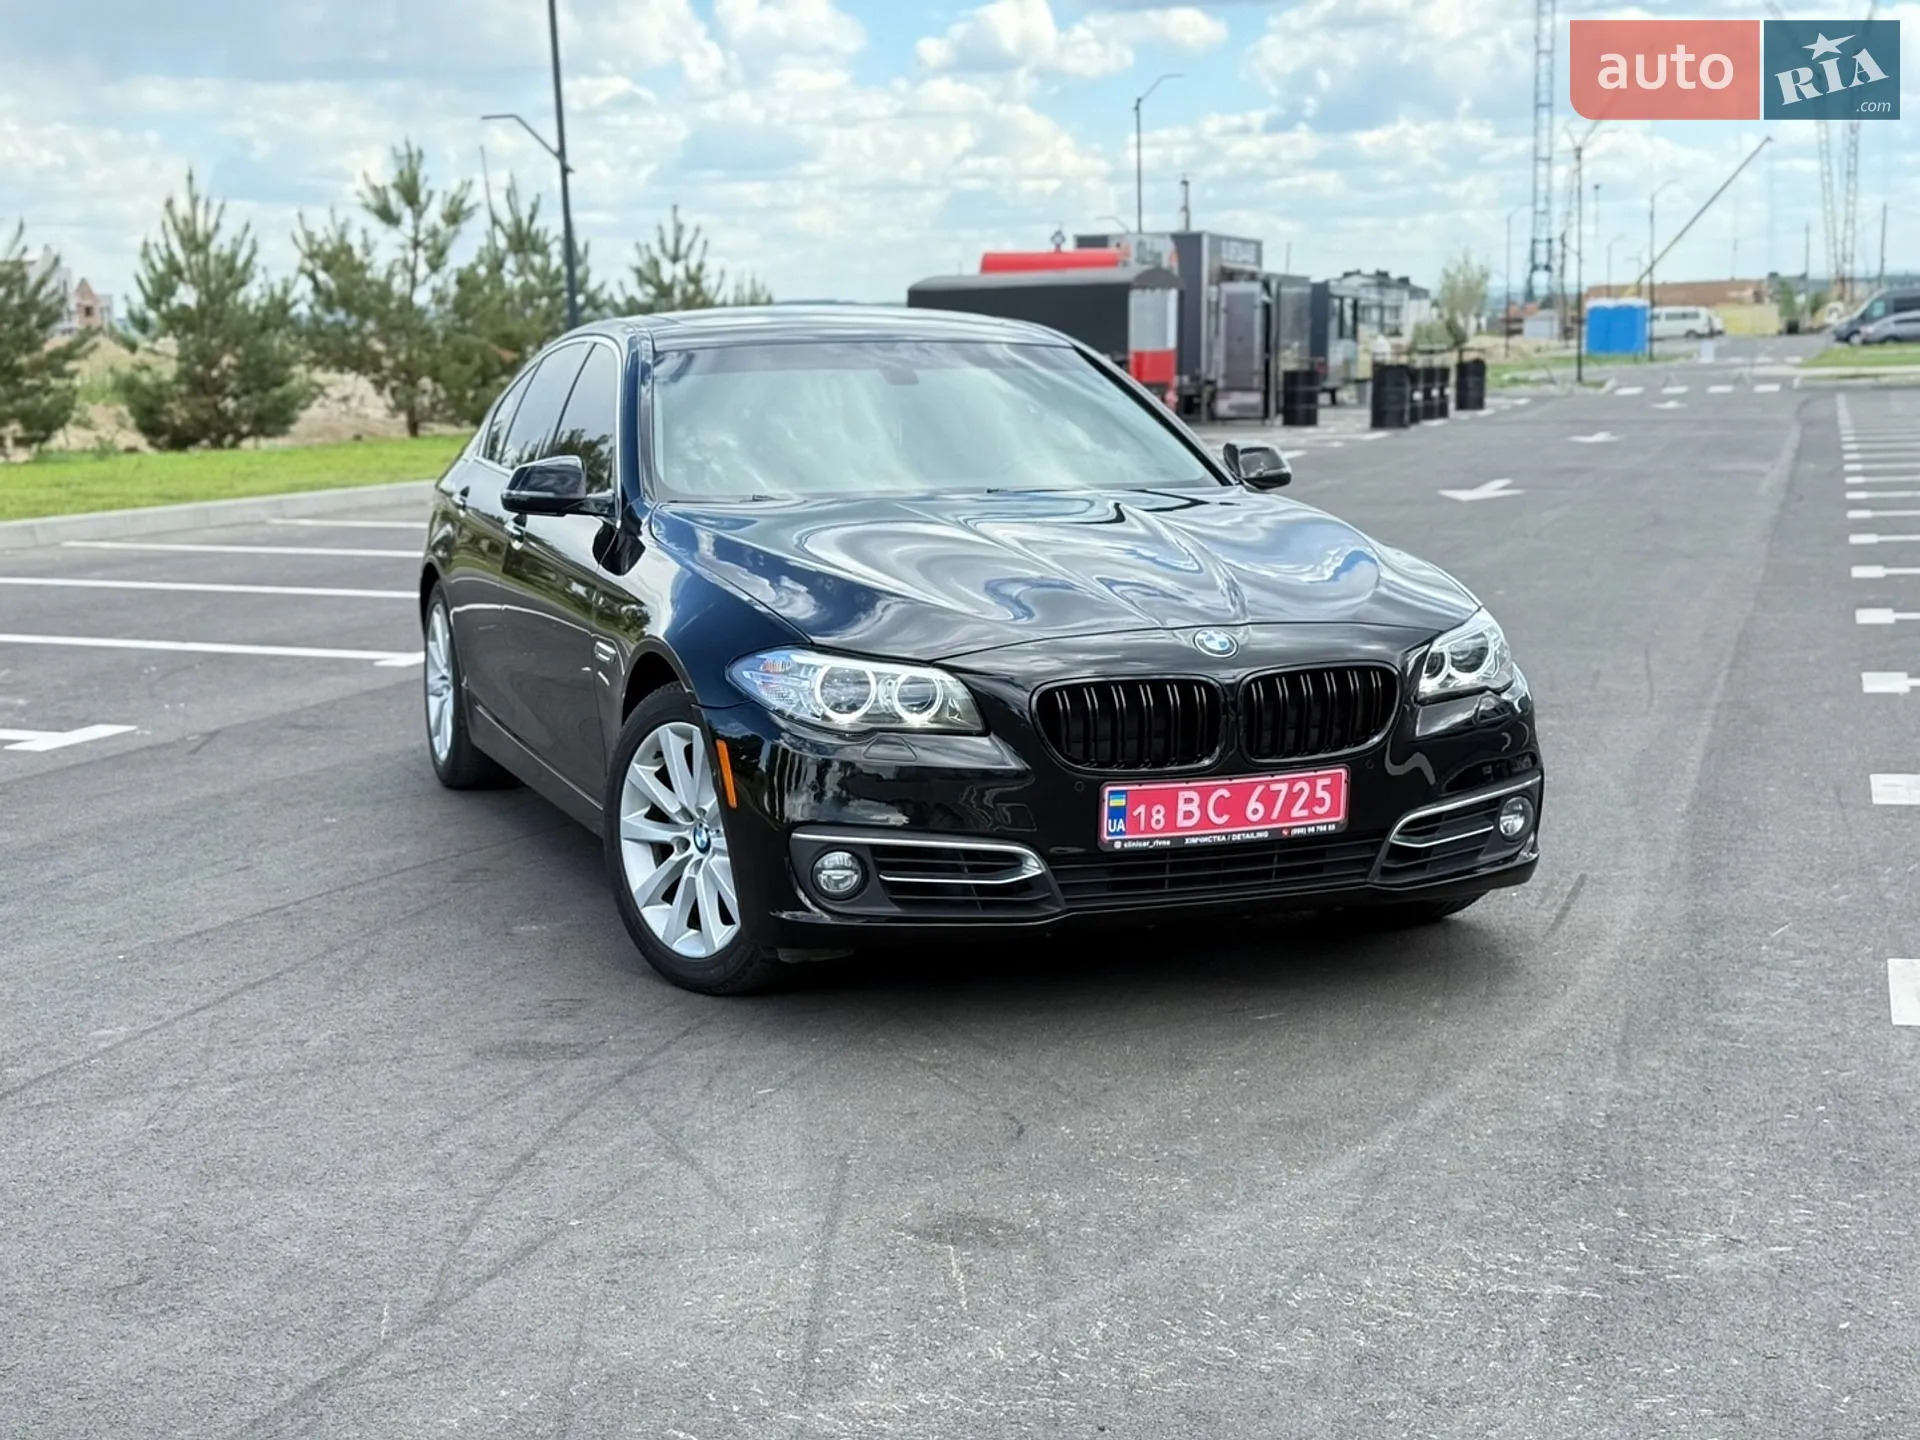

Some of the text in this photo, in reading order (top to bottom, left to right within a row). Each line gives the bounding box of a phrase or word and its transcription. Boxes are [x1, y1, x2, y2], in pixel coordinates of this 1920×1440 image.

[1132, 777, 1332, 832] 18 BC 6725
[1108, 818, 1126, 832] UA
